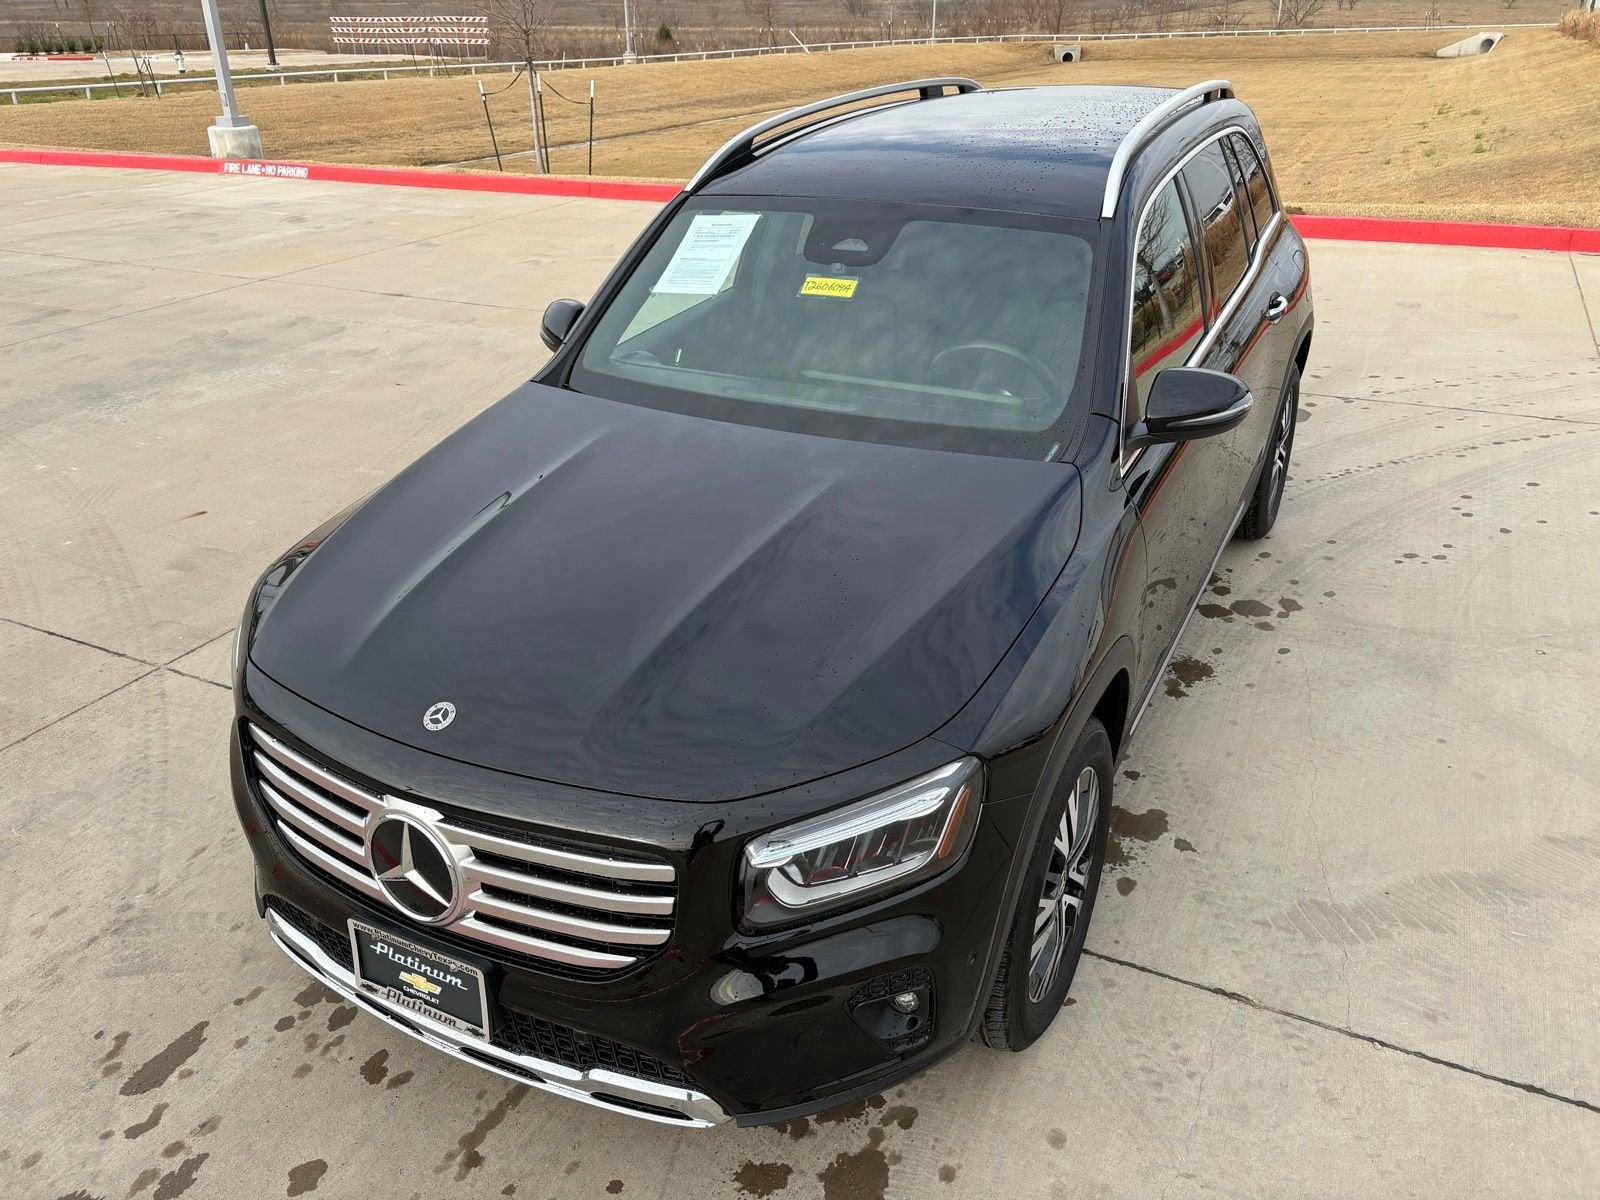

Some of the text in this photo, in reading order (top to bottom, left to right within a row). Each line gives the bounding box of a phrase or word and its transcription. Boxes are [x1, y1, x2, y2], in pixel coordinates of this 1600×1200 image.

[224, 162, 308, 178] FIRE LANE NO PARKING
[370, 942, 468, 990] Platinum
[381, 988, 463, 1031] Platinum
[403, 985, 440, 1004] CHEVROLET
